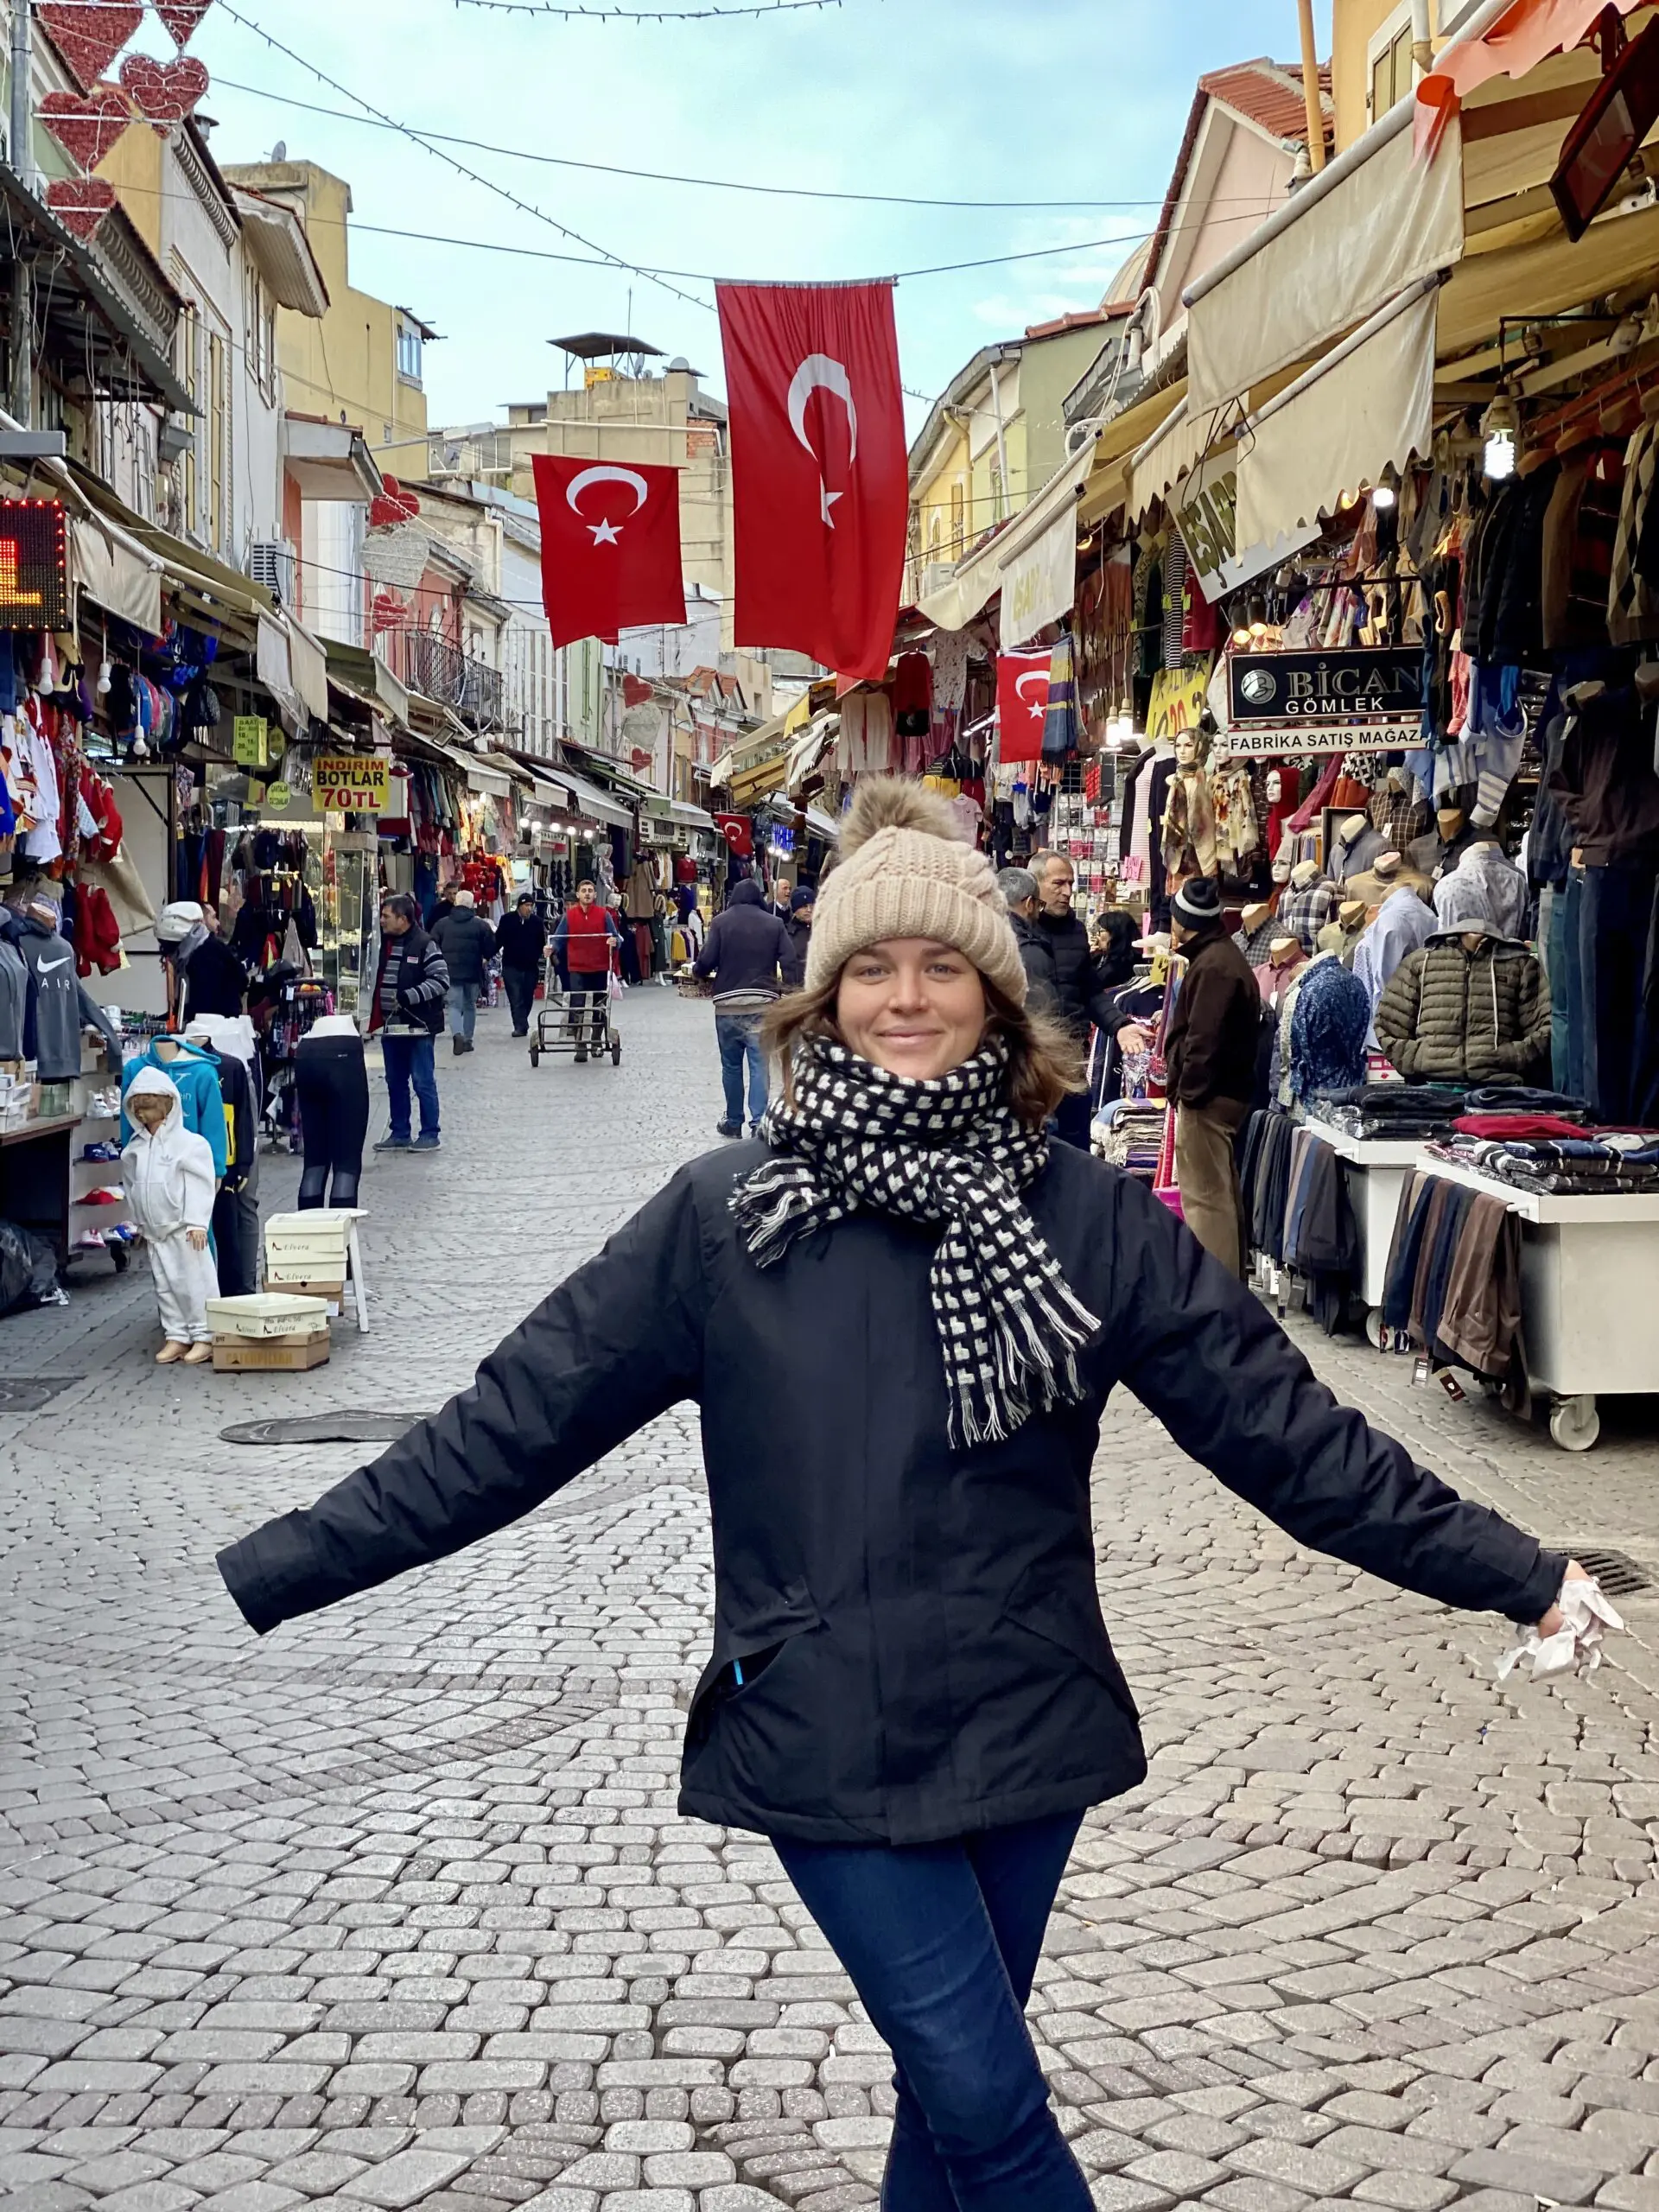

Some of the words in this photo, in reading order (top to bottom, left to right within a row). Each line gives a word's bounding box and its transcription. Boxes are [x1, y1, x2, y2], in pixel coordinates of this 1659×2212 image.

[1287, 662, 1421, 698] BİCAN
[1286, 696, 1384, 715] GÖMLEK
[1230, 734, 1303, 750] FABRİKA
[1307, 733, 1354, 748] SATIŞ
[317, 759, 384, 771] İNDİRİM
[316, 771, 384, 786] BOTLAR
[41, 977, 70, 990] AIR
